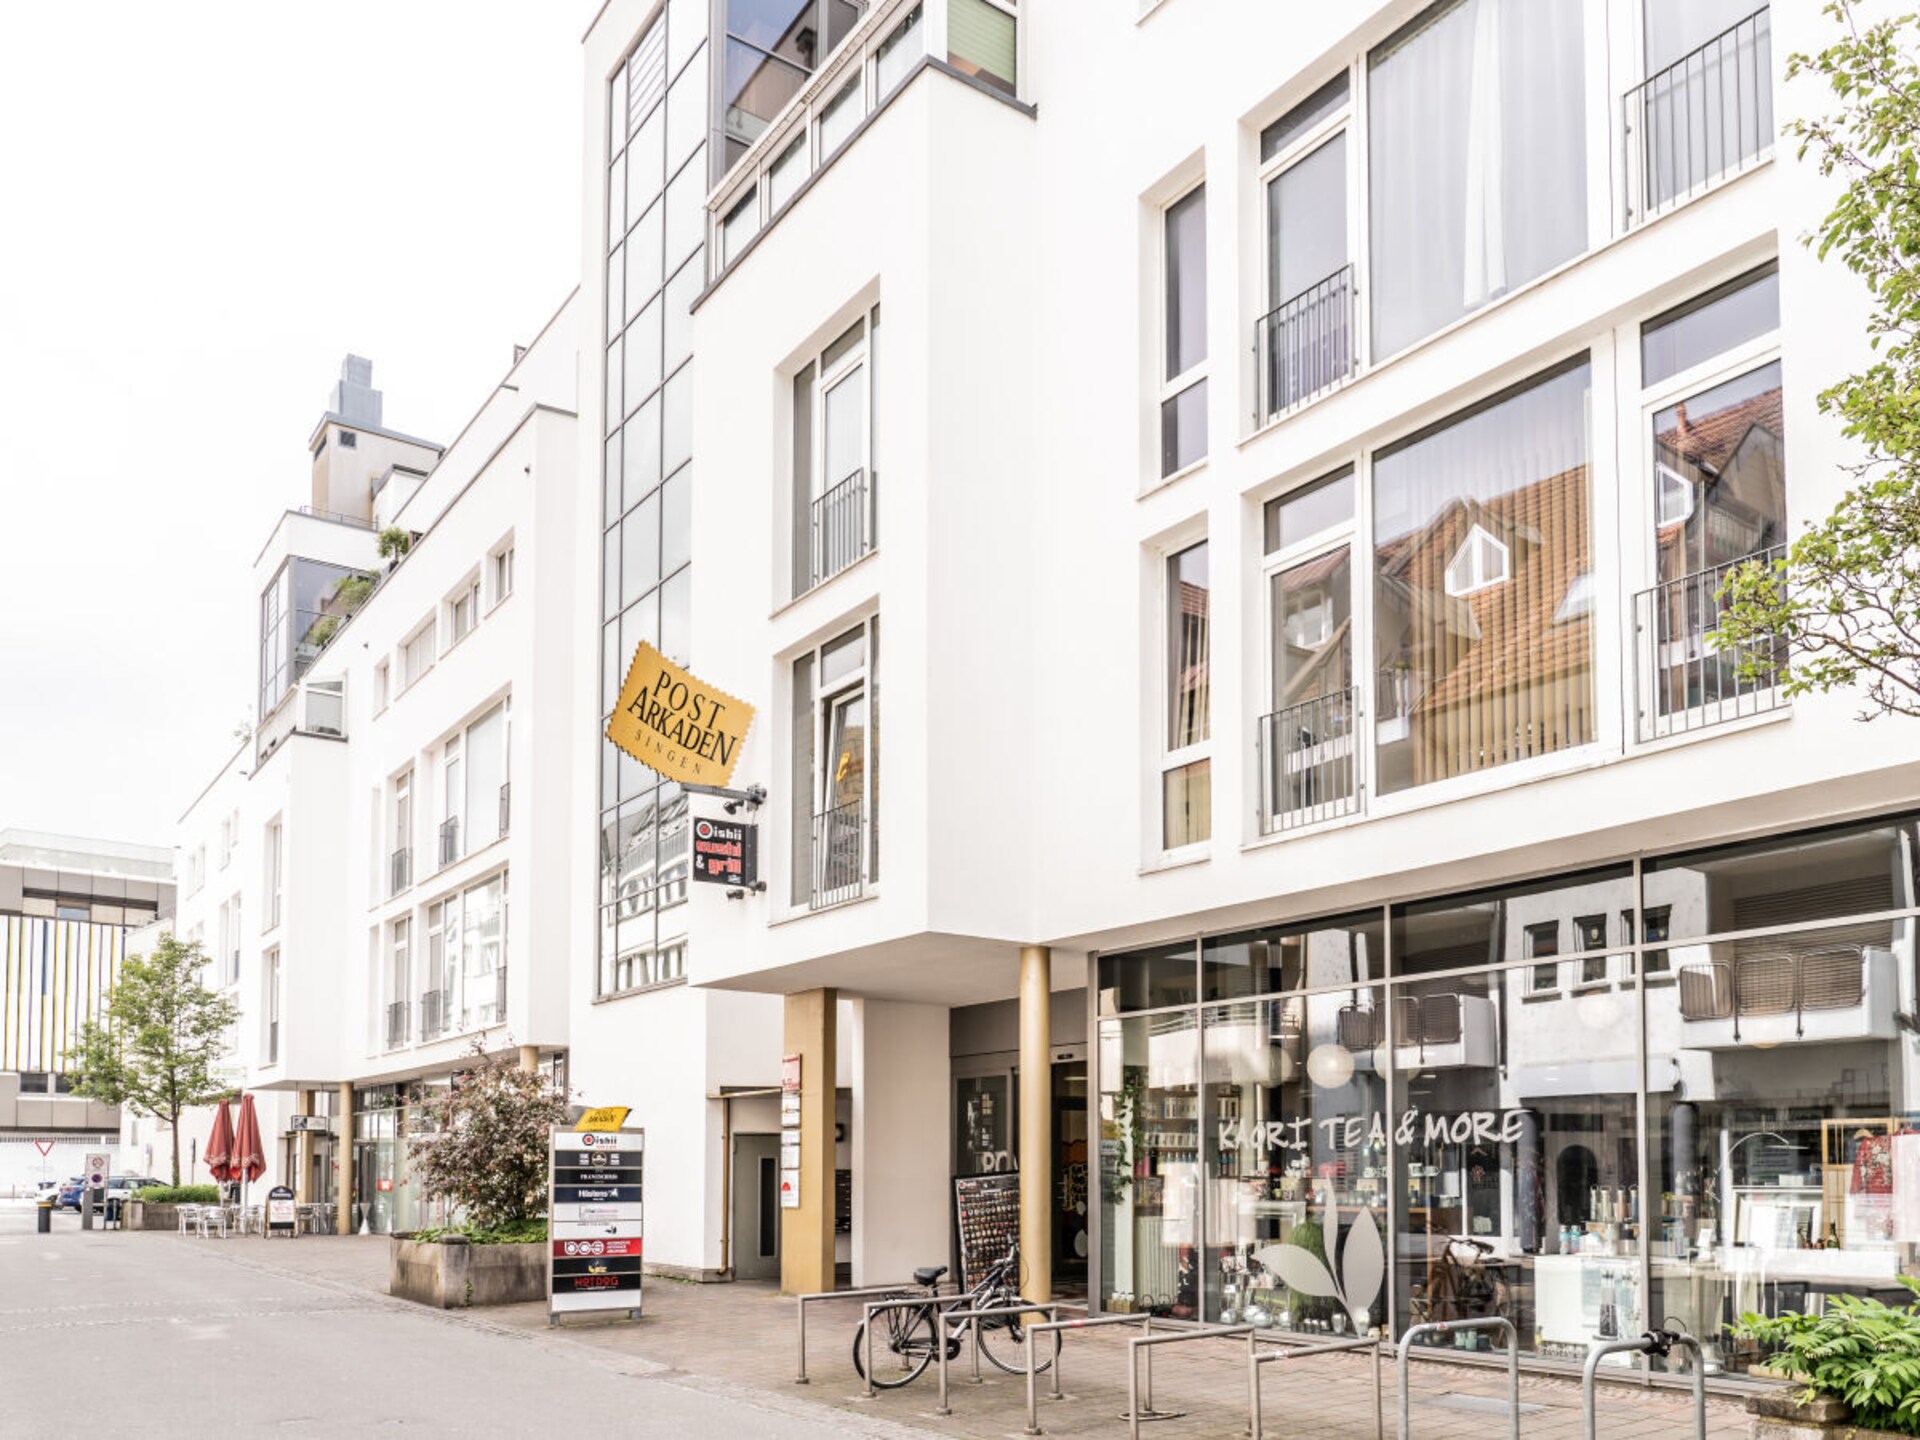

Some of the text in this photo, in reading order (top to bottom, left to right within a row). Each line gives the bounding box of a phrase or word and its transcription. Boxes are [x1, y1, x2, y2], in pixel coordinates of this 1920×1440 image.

[653, 670, 726, 730] POST
[627, 686, 738, 767] ARKADEN
[635, 729, 702, 775] SINGEN
[696, 840, 742, 857] sushi
[696, 854, 742, 876] & grill
[1218, 1109, 1533, 1151] KAORI TEA & MORE
